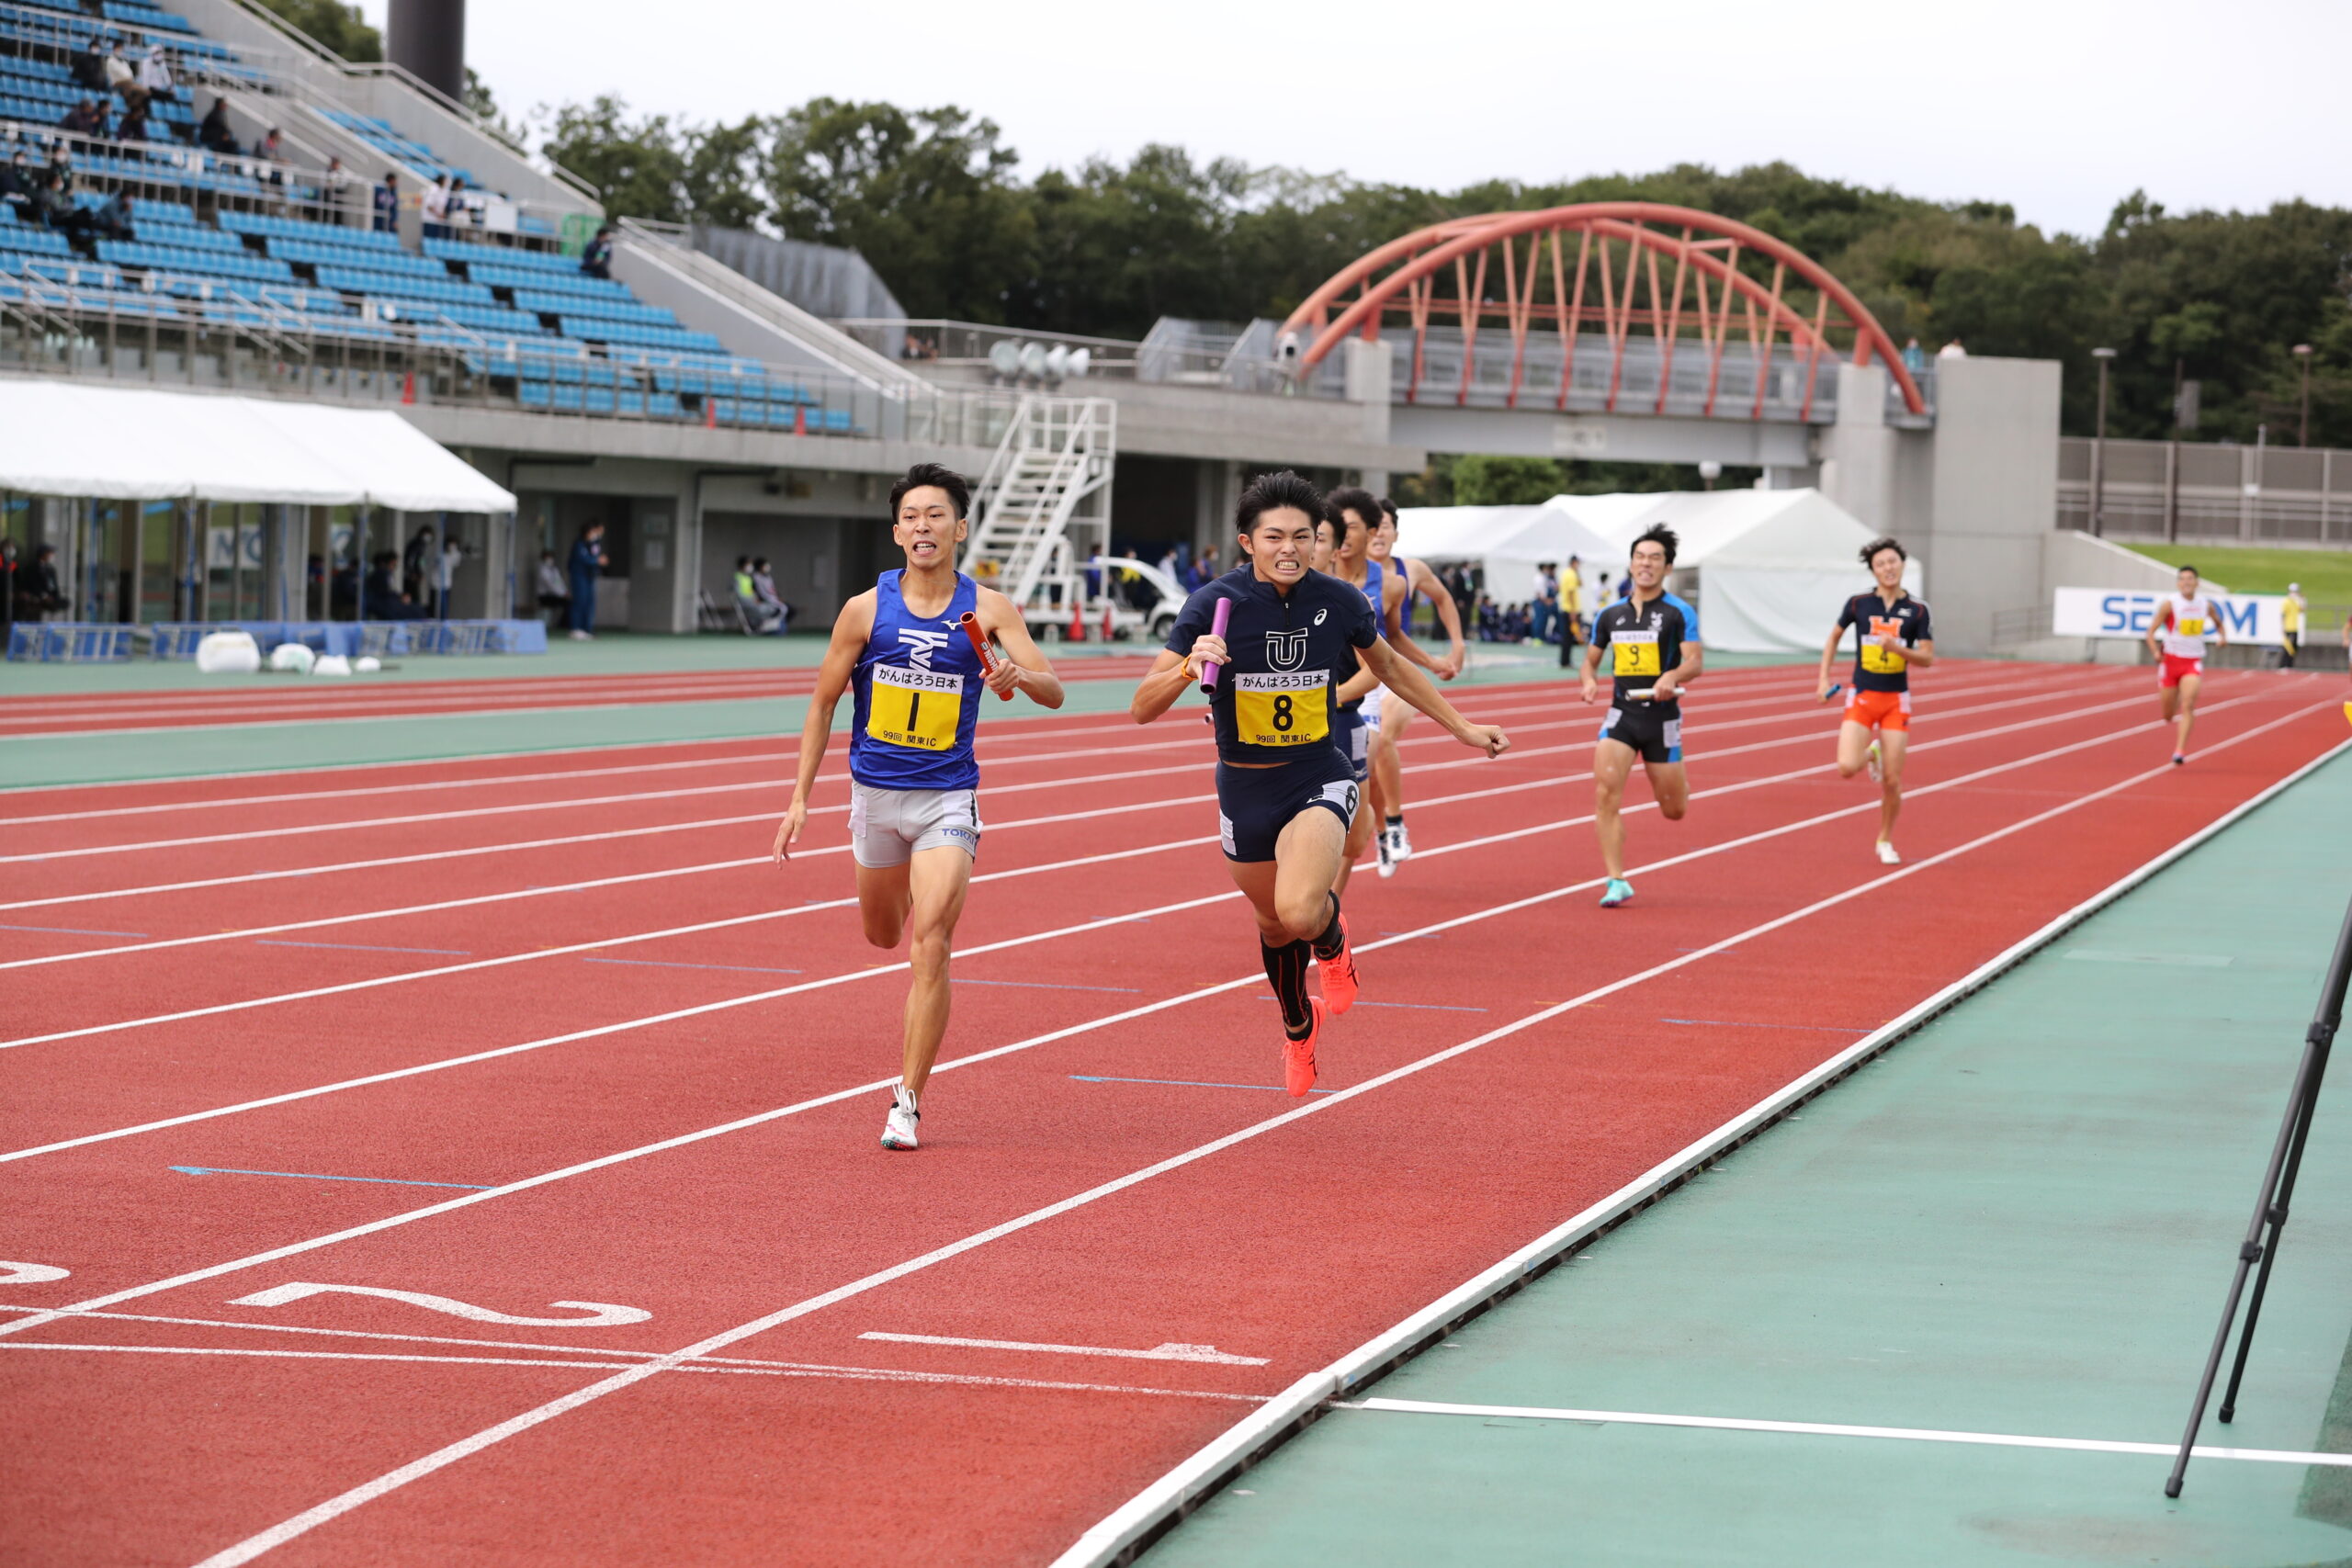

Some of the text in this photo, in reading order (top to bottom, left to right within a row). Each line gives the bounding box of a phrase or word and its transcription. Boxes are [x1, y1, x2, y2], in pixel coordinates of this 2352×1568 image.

[1630, 646, 1640, 666] 9
[878, 668, 958, 689] がんばろう日本
[1242, 674, 1324, 688] がんばろう日本
[907, 693, 920, 732] 1
[1272, 694, 1294, 732] 8
[883, 730, 937, 748] 99回 関東IC
[1255, 733, 1312, 743] 99回 関東IC
[1345, 784, 1358, 816] 8
